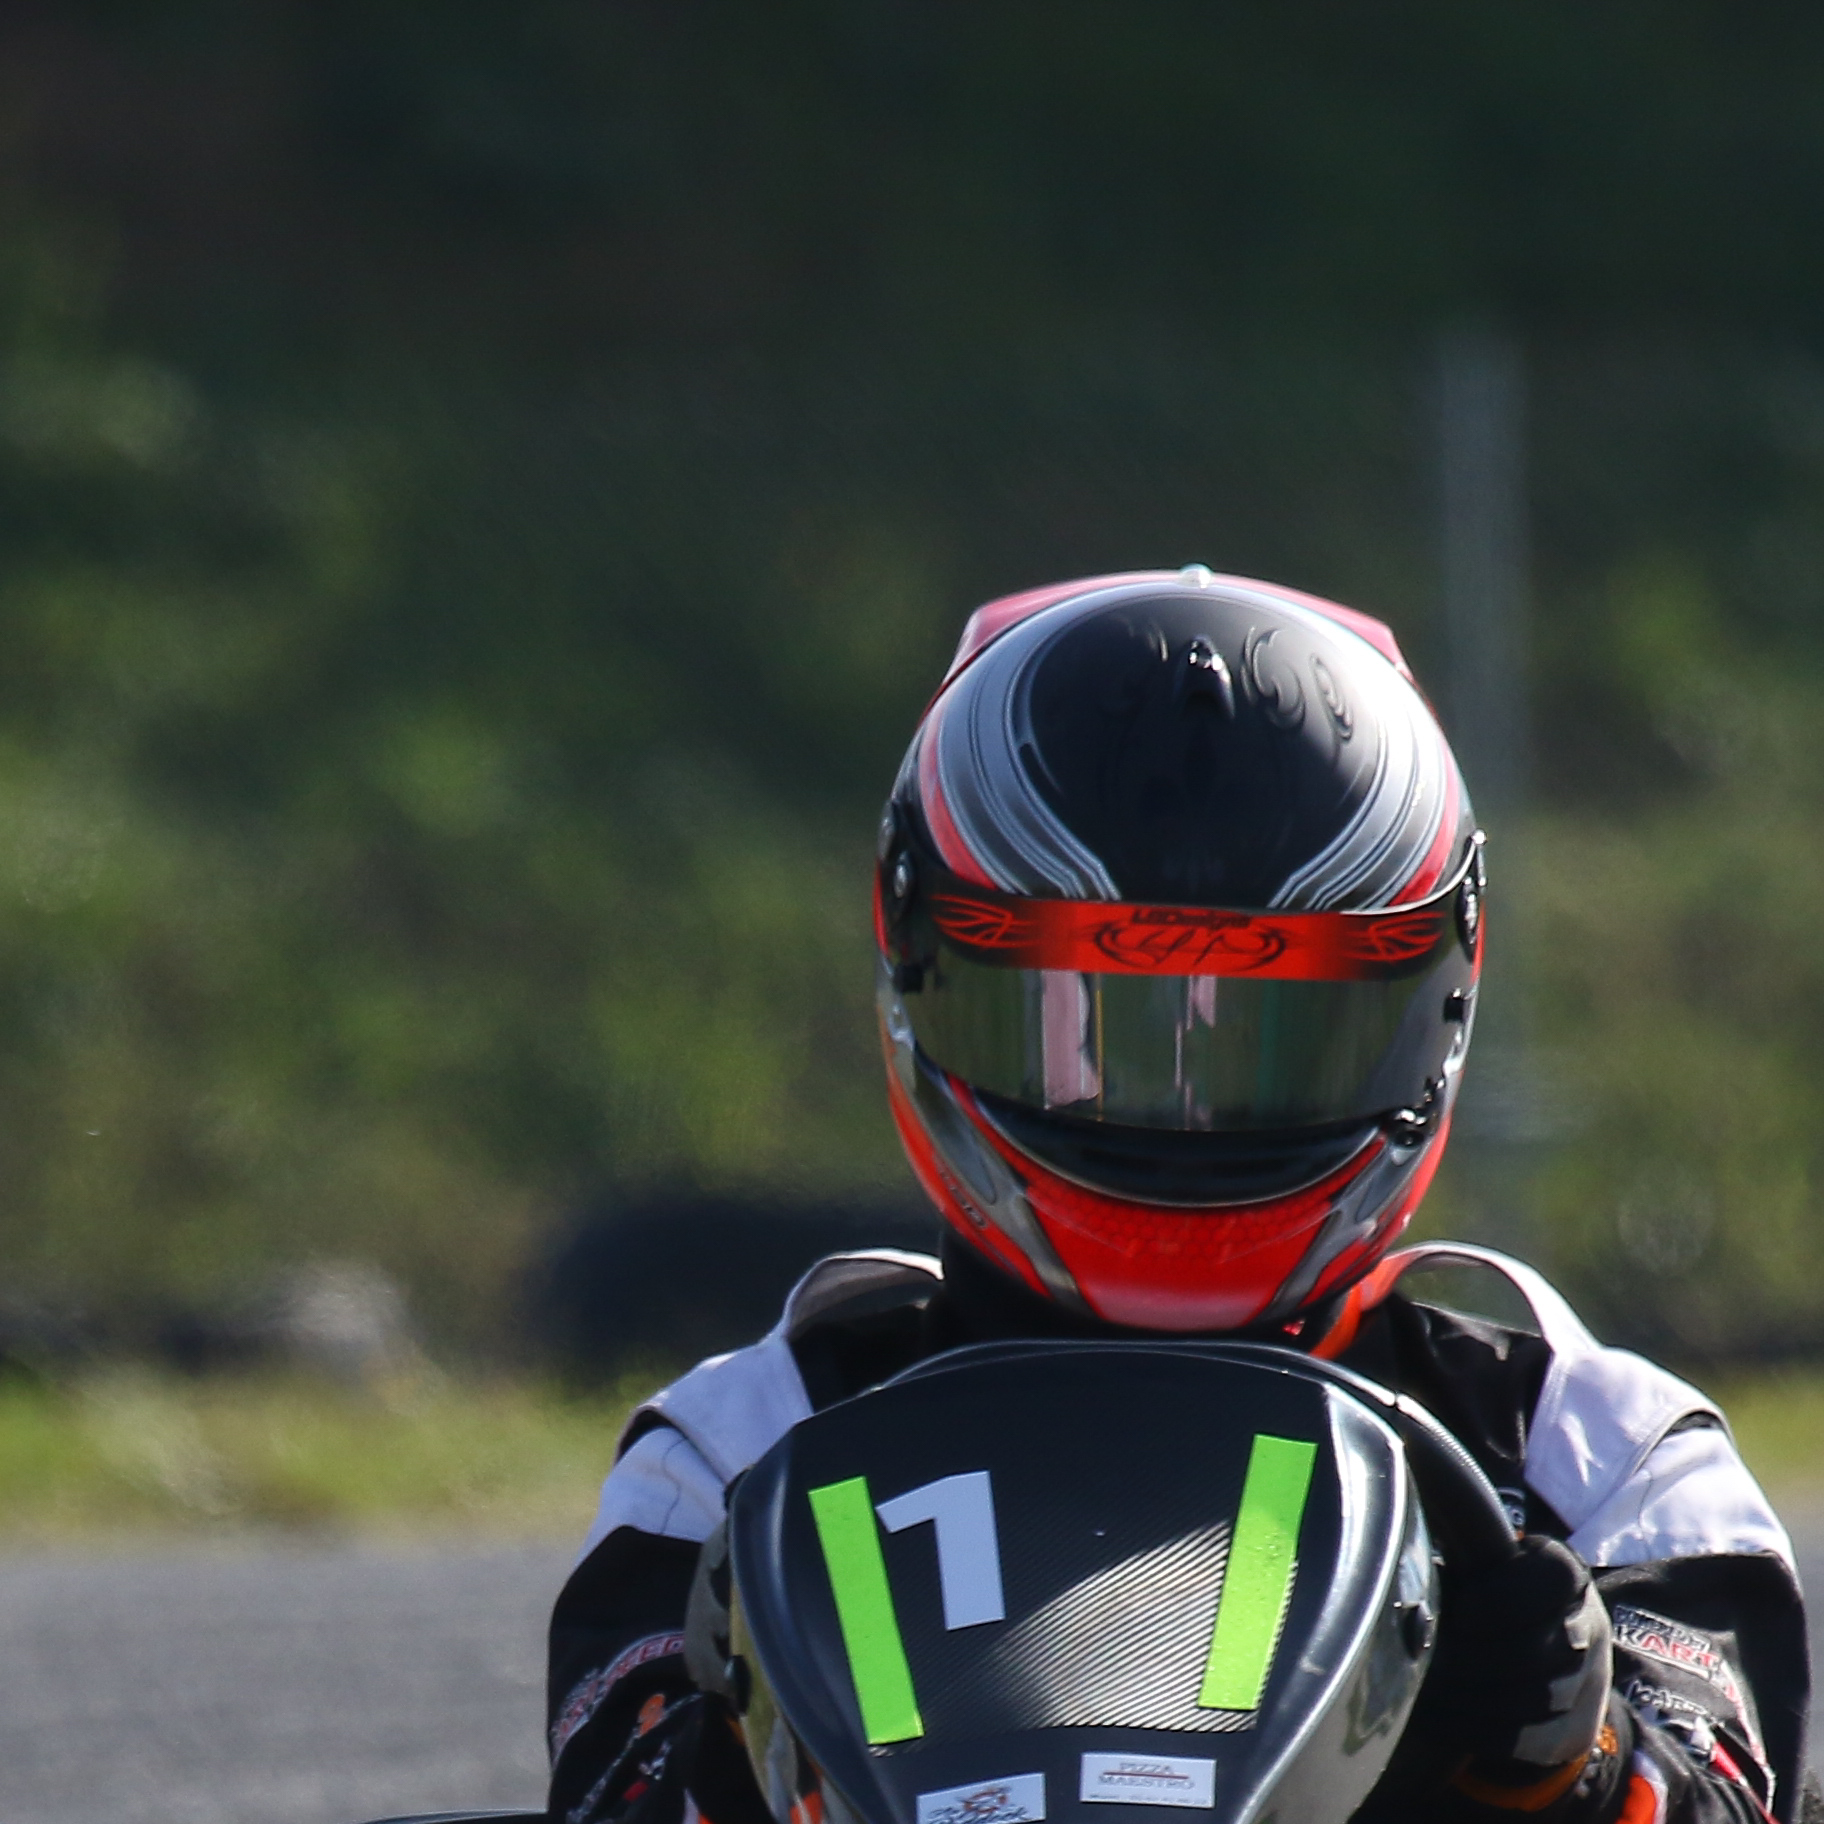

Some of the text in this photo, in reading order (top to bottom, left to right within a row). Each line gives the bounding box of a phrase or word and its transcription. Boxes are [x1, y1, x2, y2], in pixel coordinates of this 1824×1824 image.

[875, 1469, 1005, 1631] 1
[1119, 1762, 1174, 1775] PIZZA
[1097, 1774, 1196, 1790] MAESTRO
